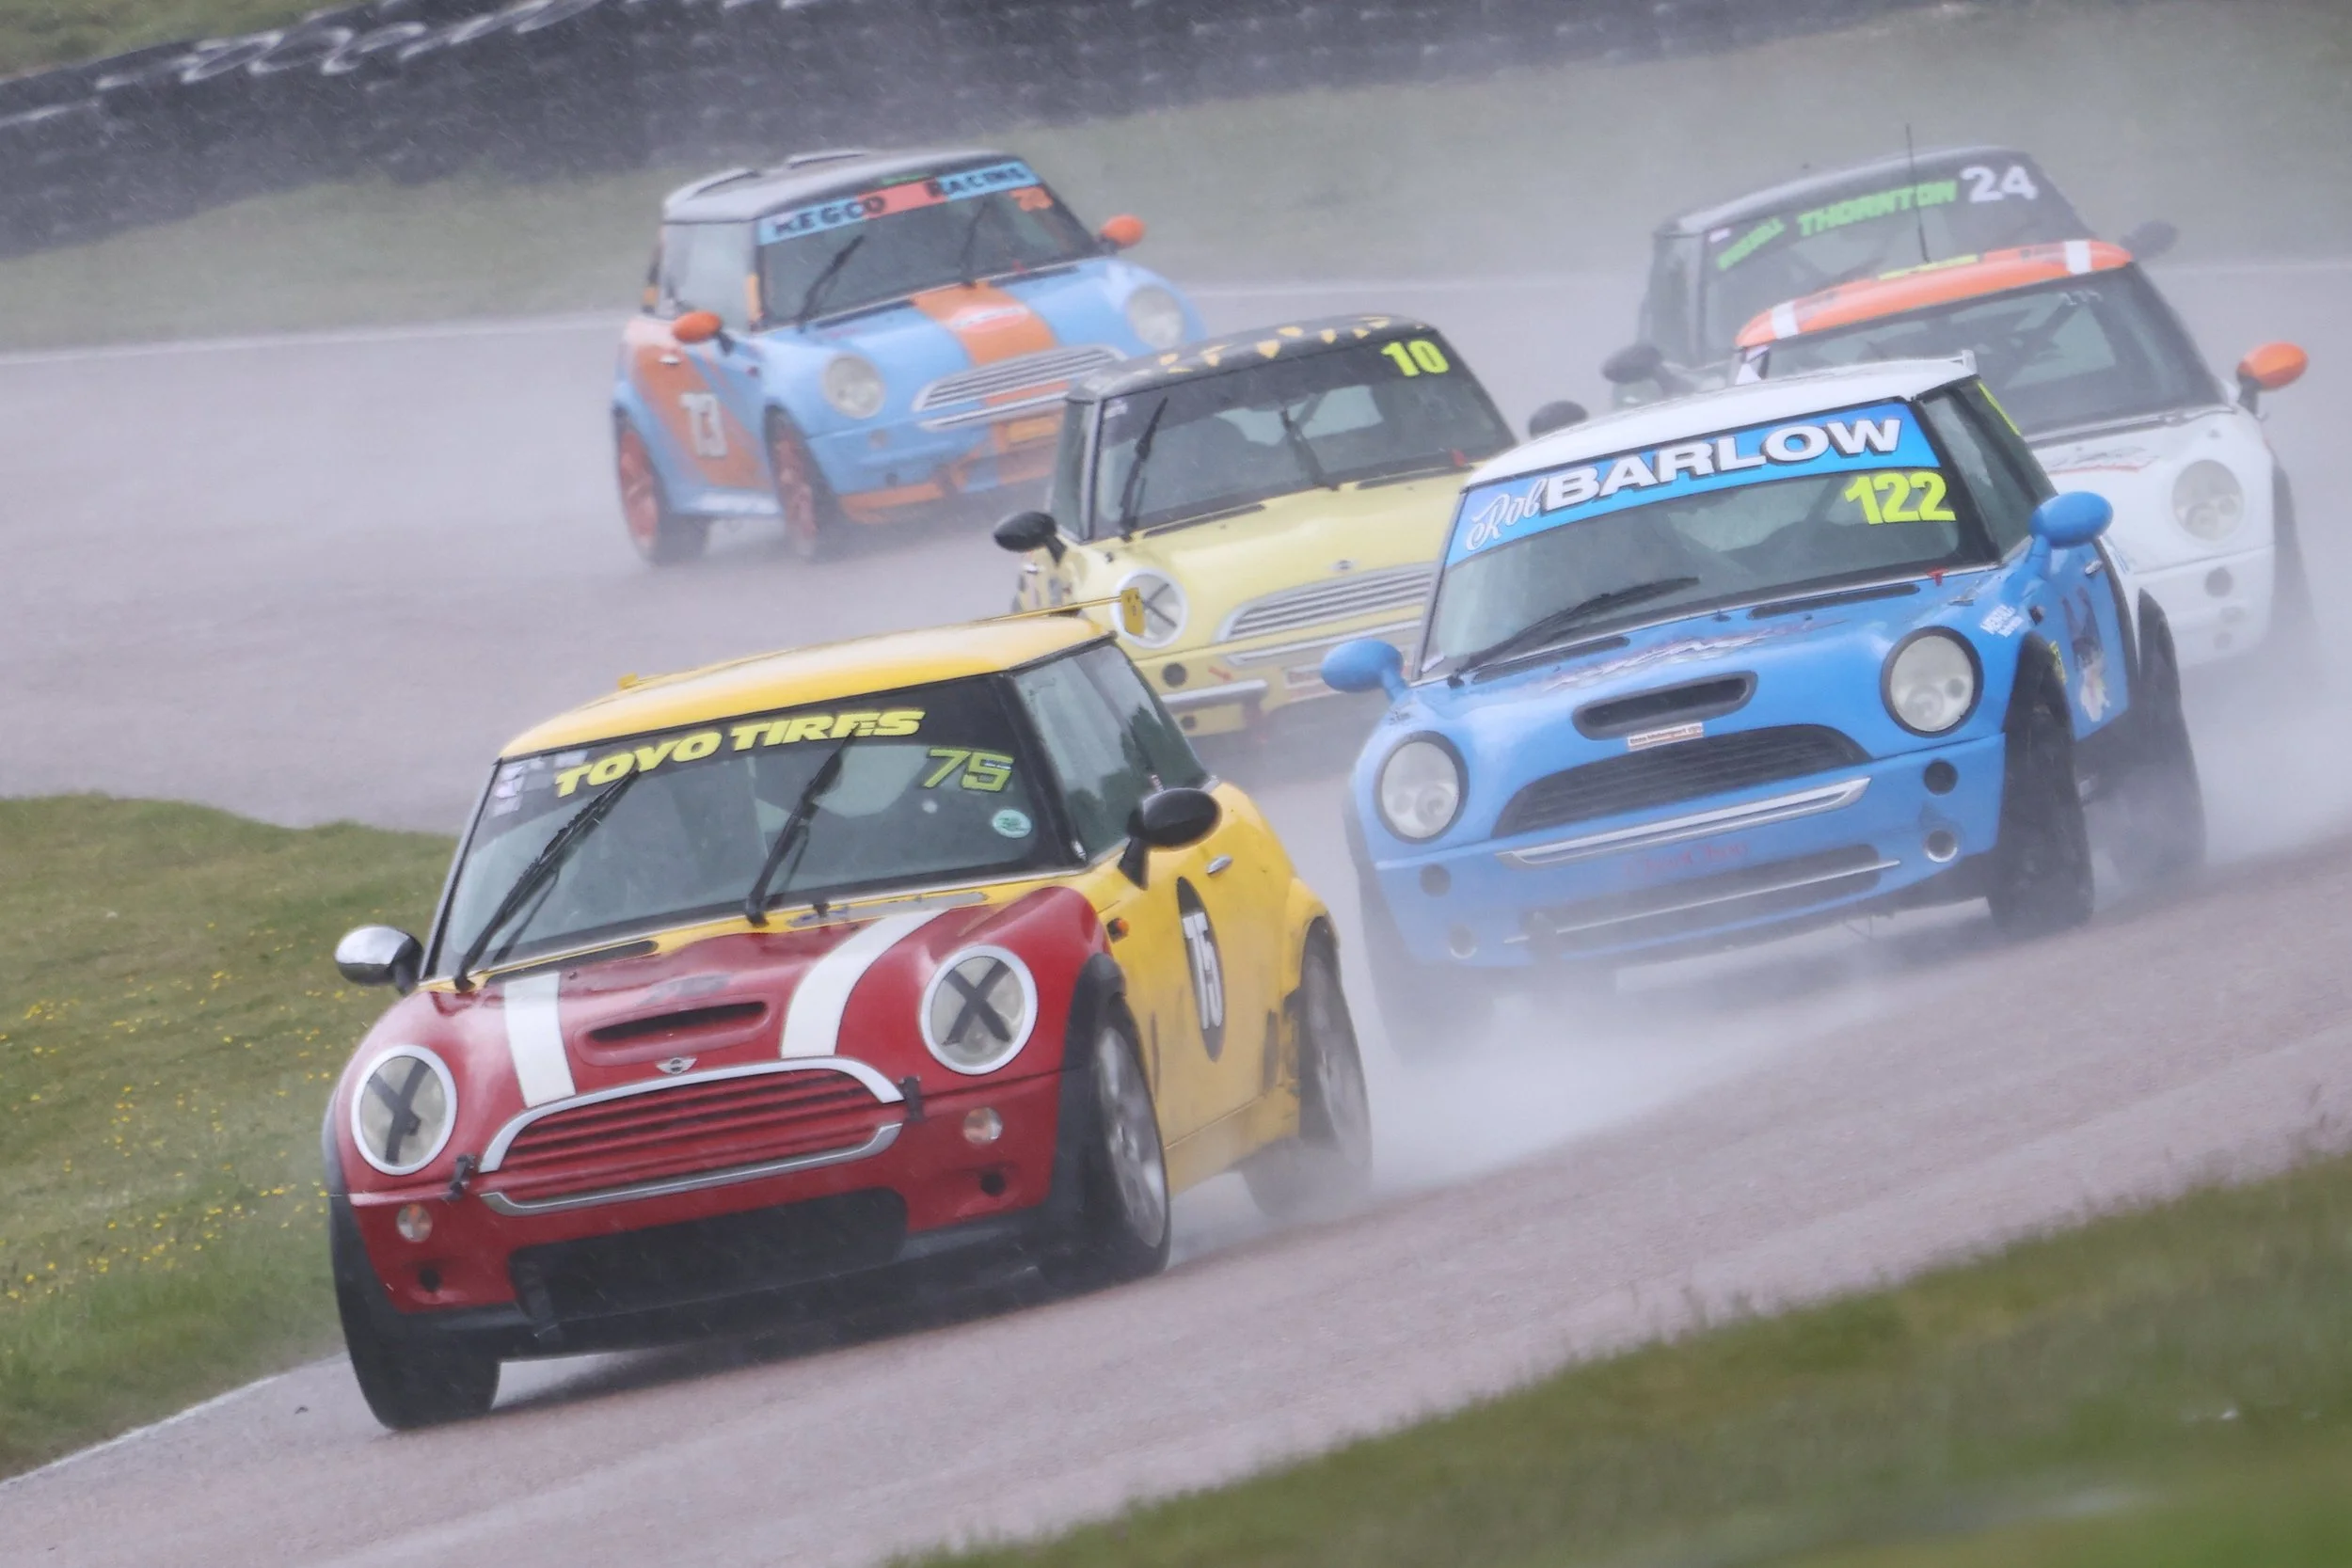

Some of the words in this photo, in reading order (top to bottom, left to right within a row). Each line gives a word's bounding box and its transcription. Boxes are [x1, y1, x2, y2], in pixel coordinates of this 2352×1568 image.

[1796, 181, 1958, 236] THORNTON
[1960, 165, 2038, 203] 24
[1380, 340, 1450, 377] 10
[1465, 478, 1541, 552] Rob
[1541, 419, 1902, 512] BARLOW
[1844, 472, 1957, 526] 122
[554, 732, 723, 799] TOYO
[730, 709, 926, 751] TIRES
[922, 747, 1014, 792] 75
